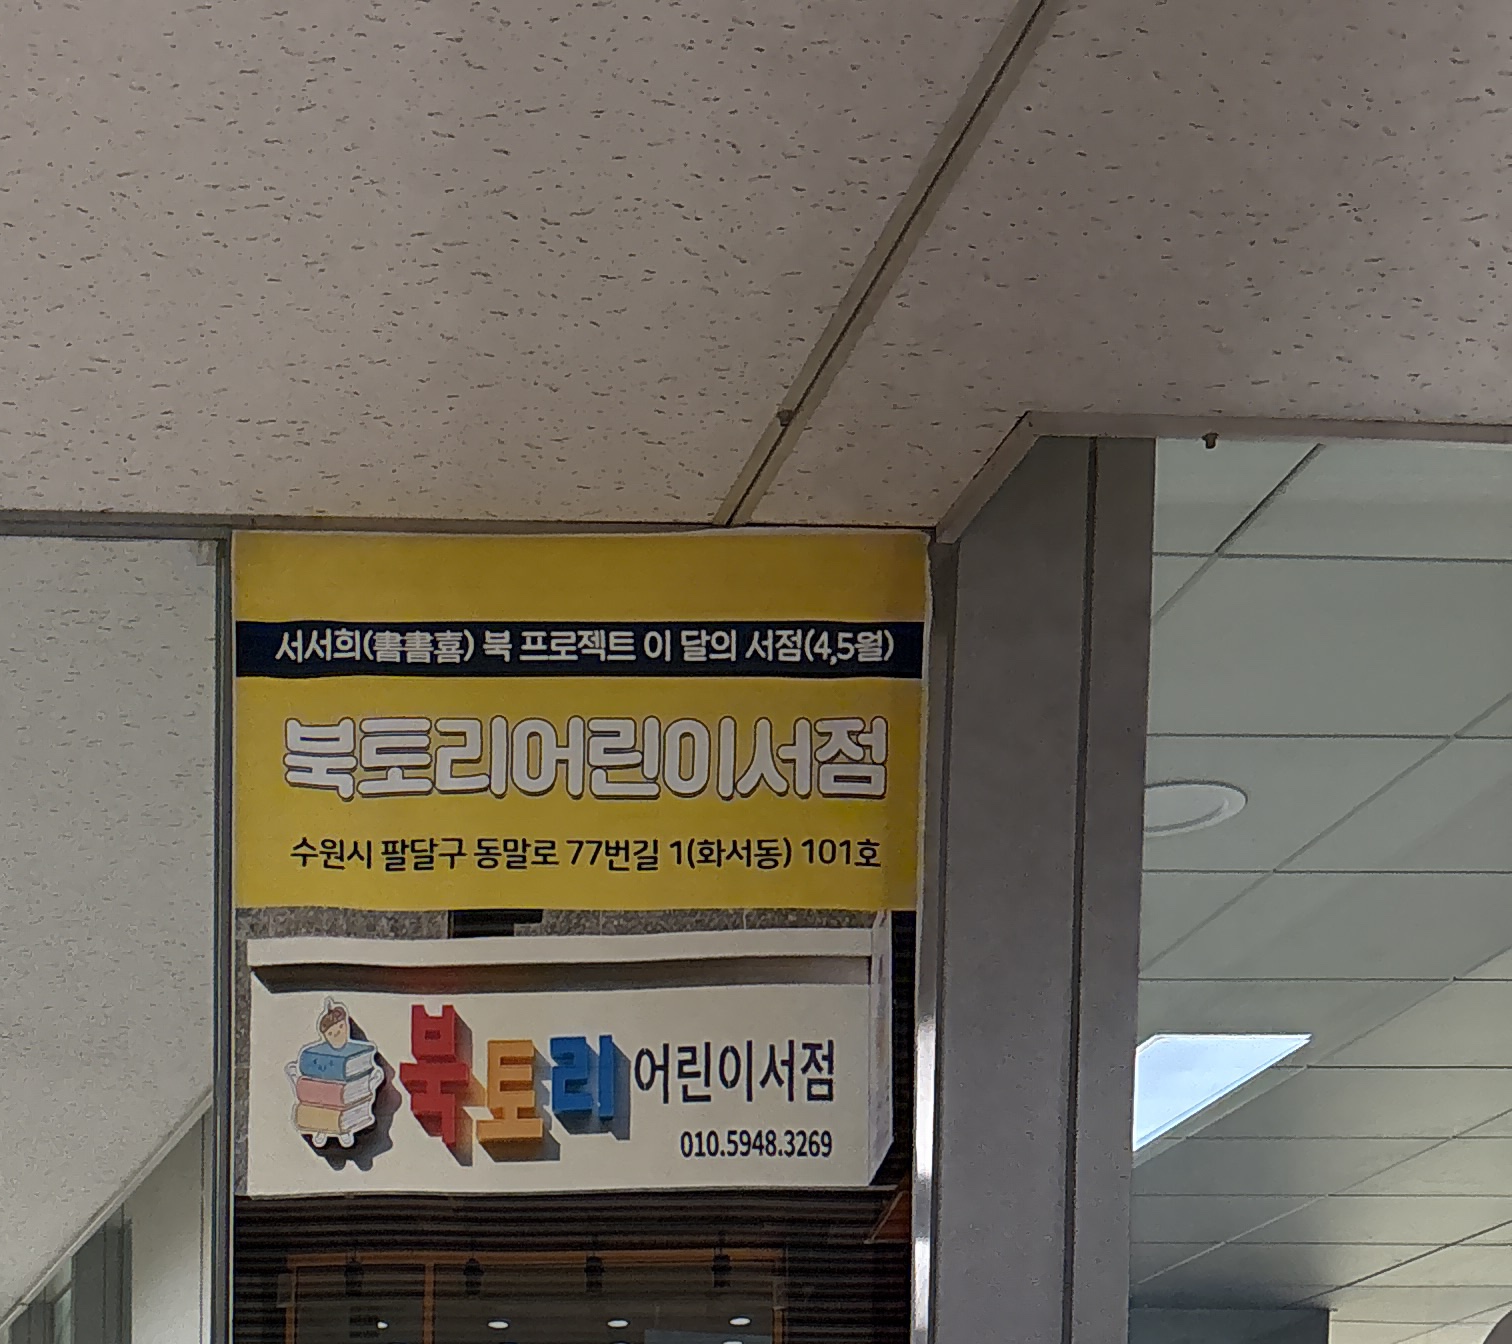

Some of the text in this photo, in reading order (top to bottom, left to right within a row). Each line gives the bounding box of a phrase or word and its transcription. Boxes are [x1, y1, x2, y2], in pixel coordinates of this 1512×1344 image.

[274, 627, 895, 667] 서서희(書書喜) 북 프로젝트 이 달의 서점(4,5월)
[283, 714, 888, 801] 북토리어린이서점
[289, 835, 882, 871] 수원시 팔달구 동말로 77번길 1(화서동) 101호
[399, 1003, 836, 1152] 북토리 어린이서점
[679, 1128, 833, 1160] 010.5948.3269
